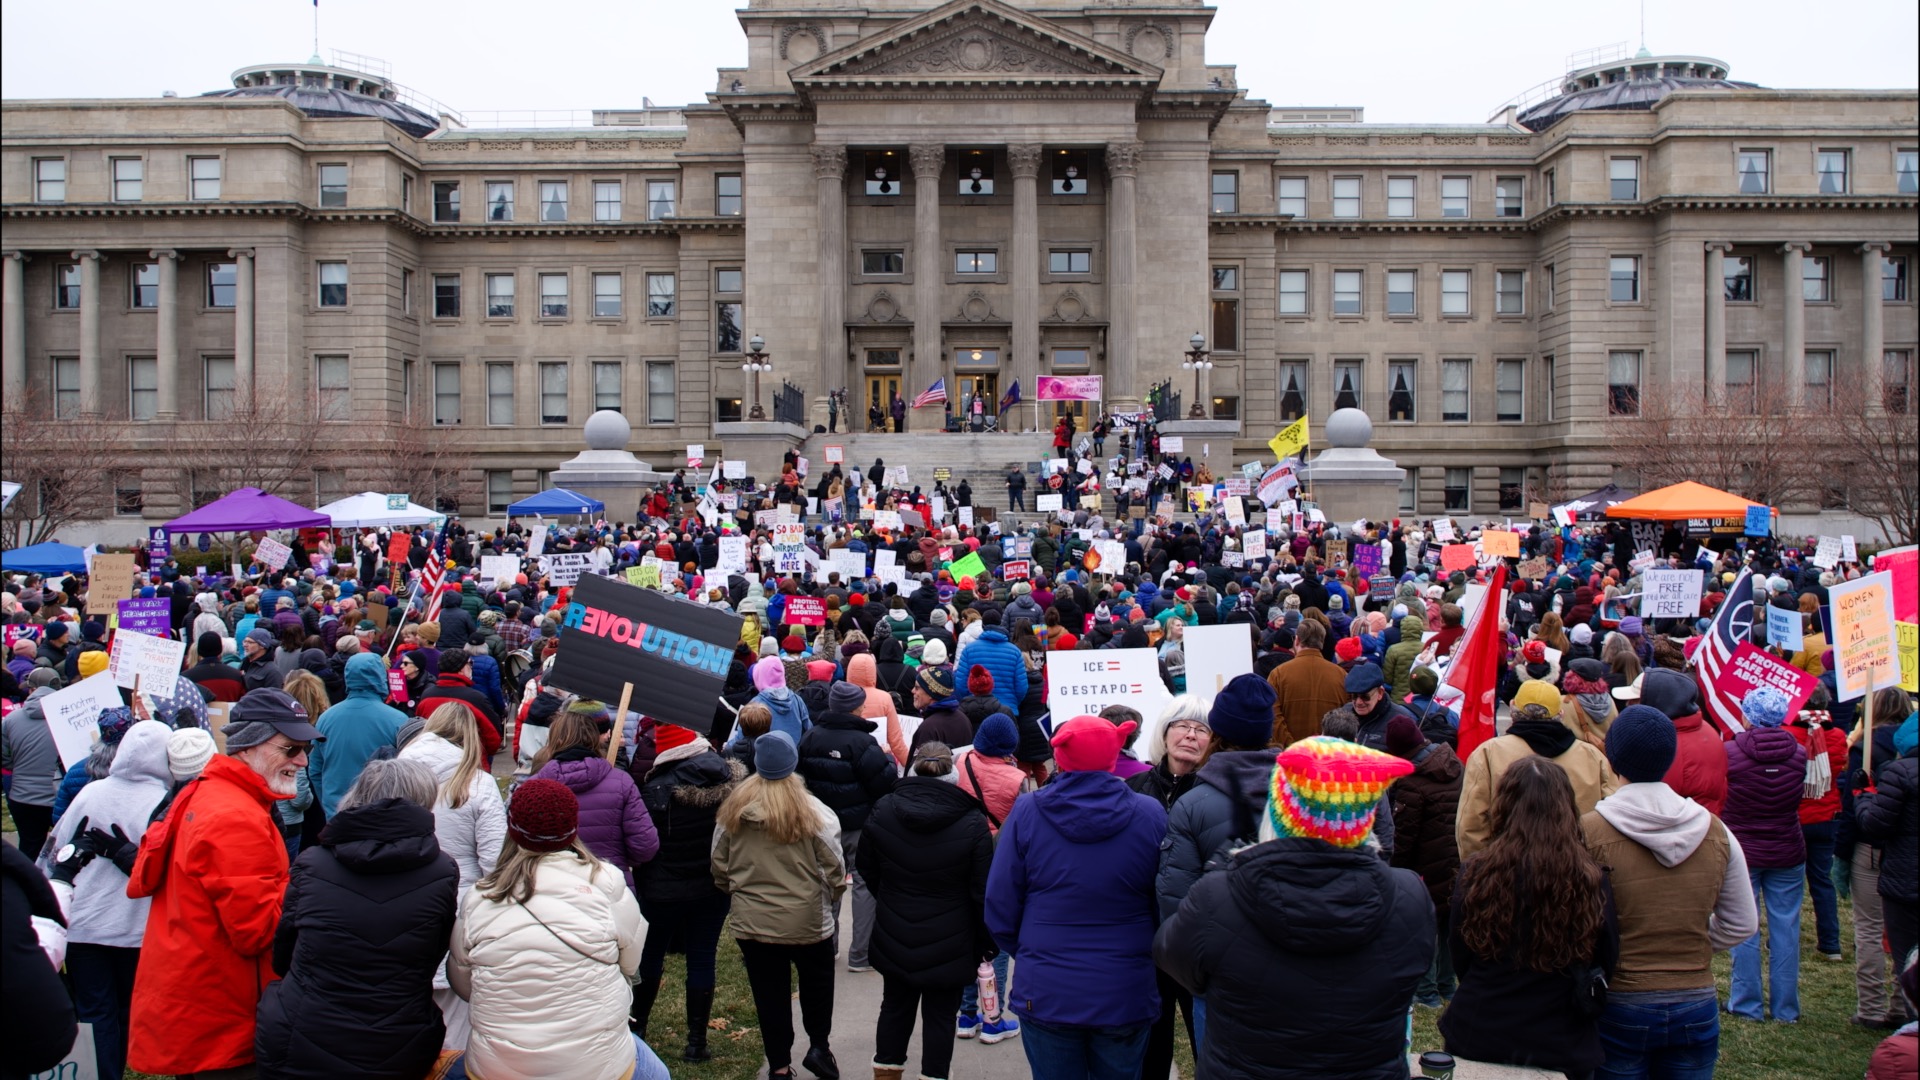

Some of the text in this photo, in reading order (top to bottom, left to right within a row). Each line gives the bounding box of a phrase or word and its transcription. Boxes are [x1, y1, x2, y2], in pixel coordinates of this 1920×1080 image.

[1049, 477, 1061, 487] STOP
[1688, 518, 1708, 527] BACK
[1711, 518, 1721, 527] TO
[776, 525, 804, 534] SO BAD
[774, 543, 804, 552] INTROVERTS
[782, 552, 797, 560] ARE
[781, 561, 800, 571] HERE
[630, 575, 657, 588] WOMEN
[1645, 572, 1695, 583] We are not
[1659, 583, 1684, 593] FREE
[142, 600, 164, 608] WANT
[1839, 590, 1874, 610] WOMEN
[122, 610, 169, 618] HEALTHCARE
[1657, 602, 1684, 614] FREE
[1841, 604, 1872, 625] BELONG
[1850, 631, 1865, 642] ALL
[146, 638, 179, 649] AMERICA
[1842, 634, 1889, 658] PLACES WHERE
[145, 653, 176, 665] TYRANTS
[1843, 646, 1889, 668] DECISIONS ARE
[152, 665, 174, 677] THEIR
[1083, 661, 1104, 672] ICE
[1749, 652, 1801, 682] PROTECT
[1846, 664, 1867, 679] BEING
[145, 674, 170, 686] ASSES
[1734, 656, 1802, 698] SAFE, LEGAL
[145, 683, 169, 697] OUT!
[1060, 684, 1127, 696] GESTAPO
